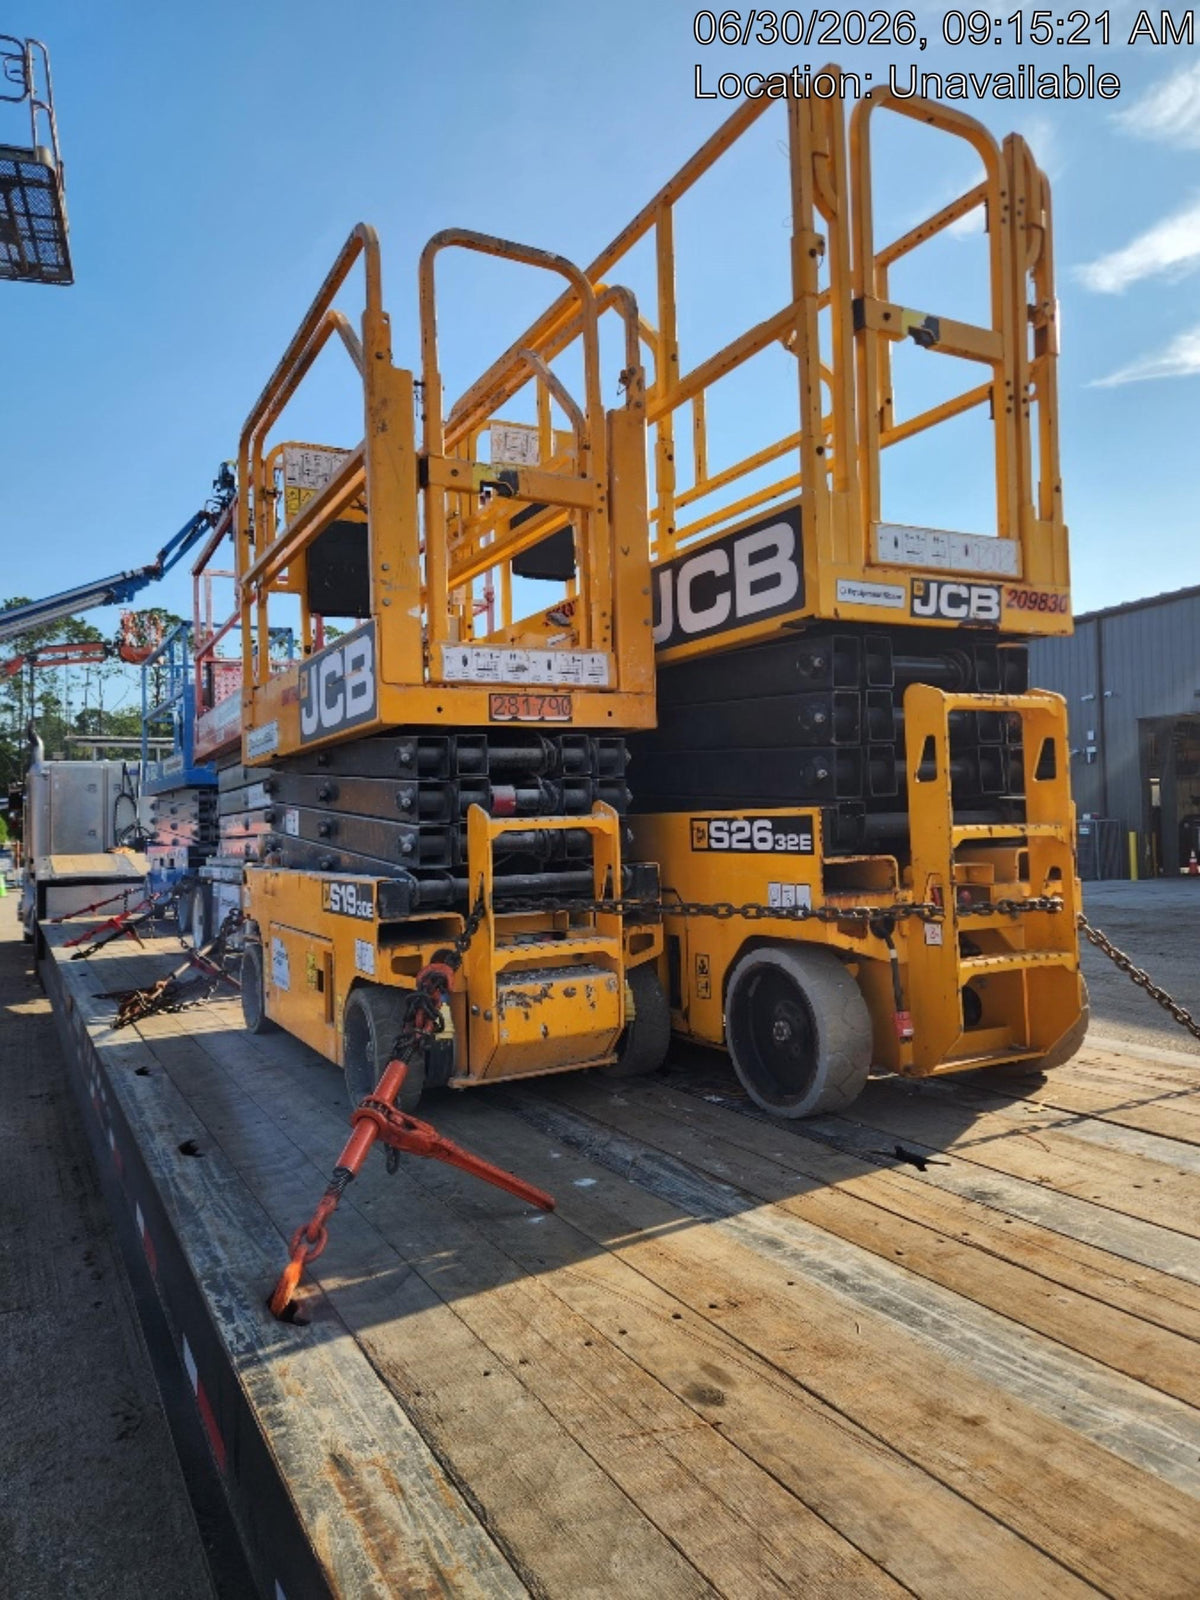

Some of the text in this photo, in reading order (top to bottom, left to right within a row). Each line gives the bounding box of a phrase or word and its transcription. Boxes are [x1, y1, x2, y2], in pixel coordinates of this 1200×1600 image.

[652, 522, 799, 645] JCB
[913, 582, 1000, 620] JCB
[301, 634, 374, 736] JCB
[493, 695, 572, 716] 281790
